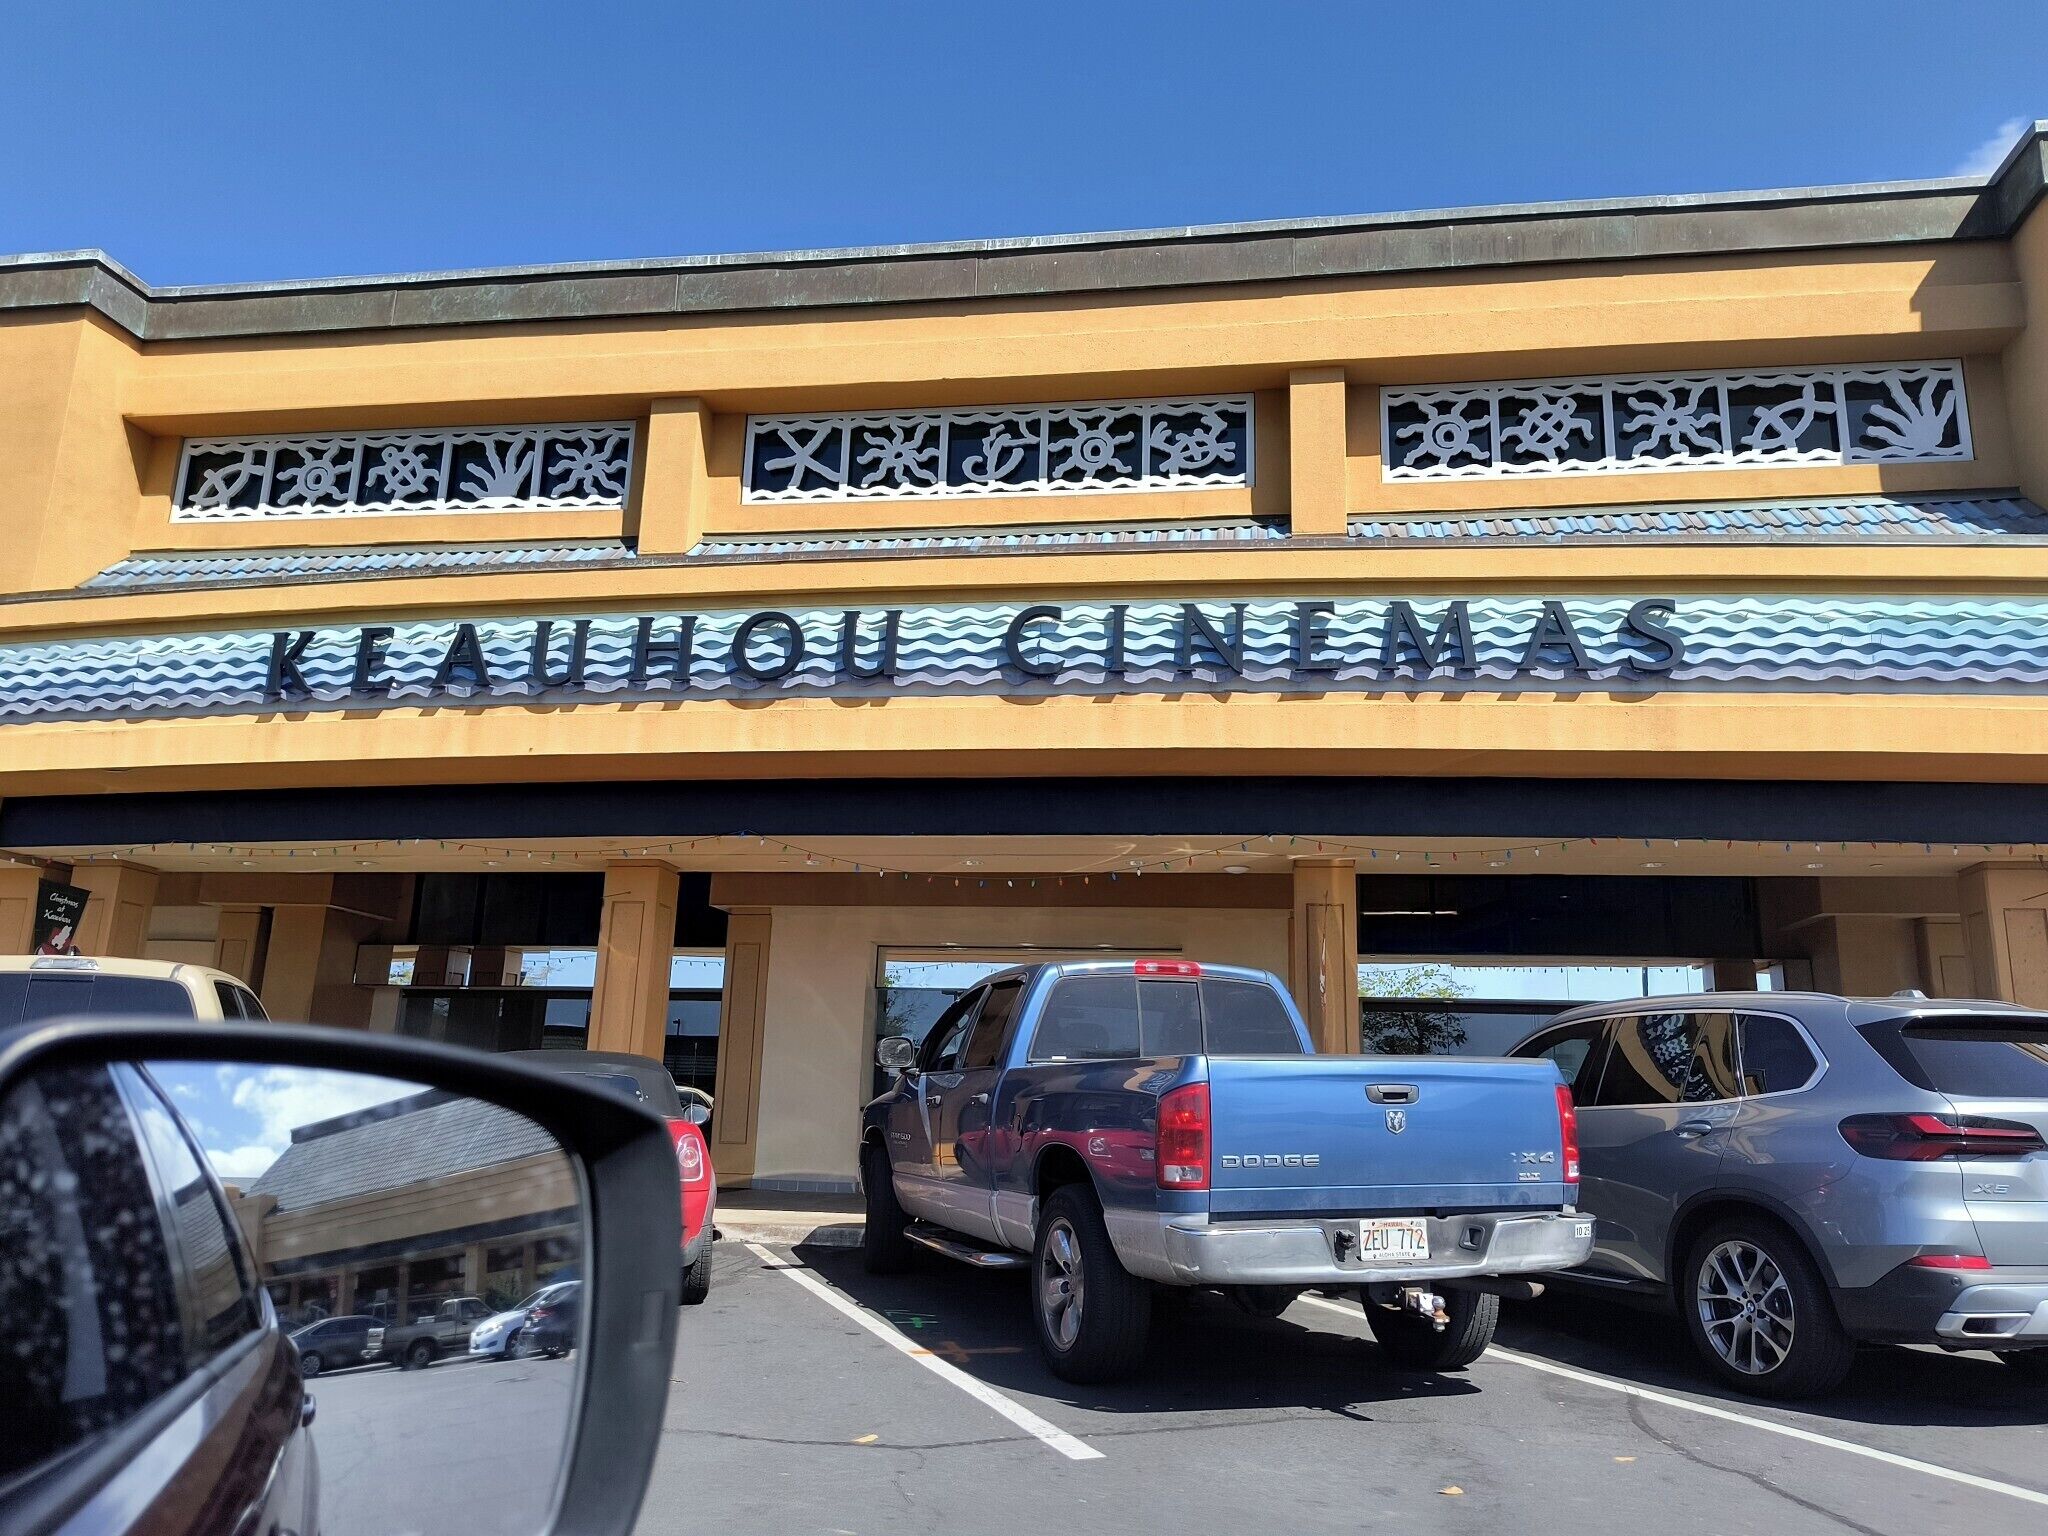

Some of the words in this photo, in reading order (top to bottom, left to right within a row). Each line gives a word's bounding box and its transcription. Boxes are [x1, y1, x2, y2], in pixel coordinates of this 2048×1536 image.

[263, 610, 904, 695] KEAUHOU
[1004, 598, 1686, 676] CINEMAS
[1222, 1153, 1320, 1169] DODGE
[1972, 1183, 2010, 1195] X5
[1363, 1229, 1389, 1251] ZEU
[1397, 1228, 1425, 1250] 772
